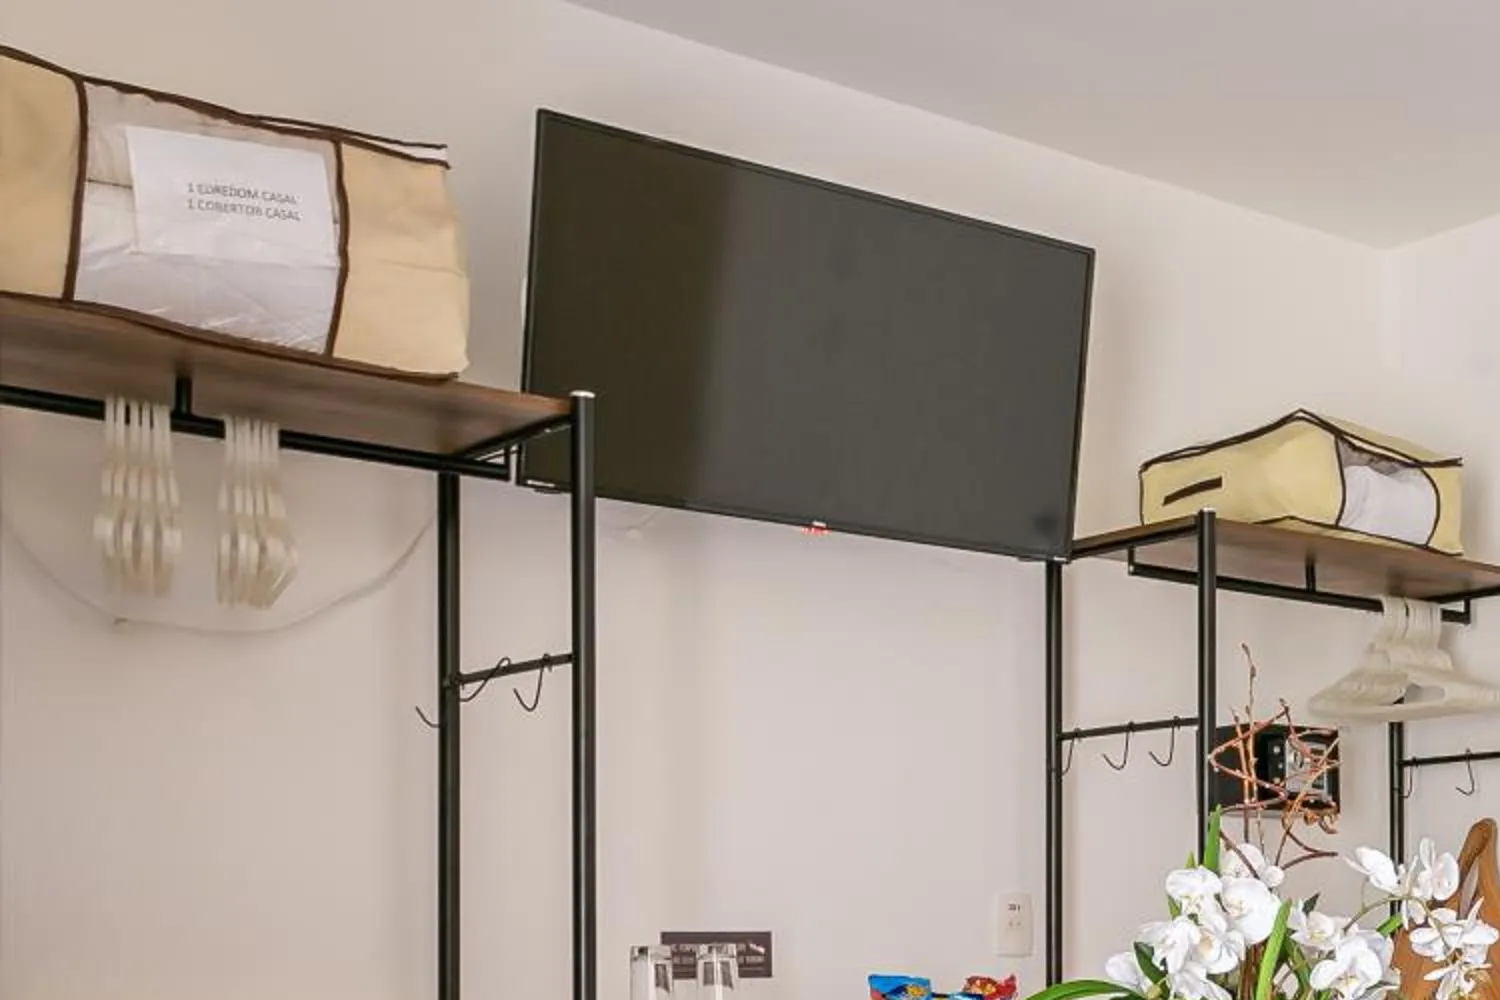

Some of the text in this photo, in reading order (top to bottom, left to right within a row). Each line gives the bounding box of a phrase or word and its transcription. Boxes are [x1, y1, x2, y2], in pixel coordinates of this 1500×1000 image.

[262, 191, 298, 205] CASAL
[197, 199, 262, 217] COBERTOR
[265, 207, 301, 221] CASAL
